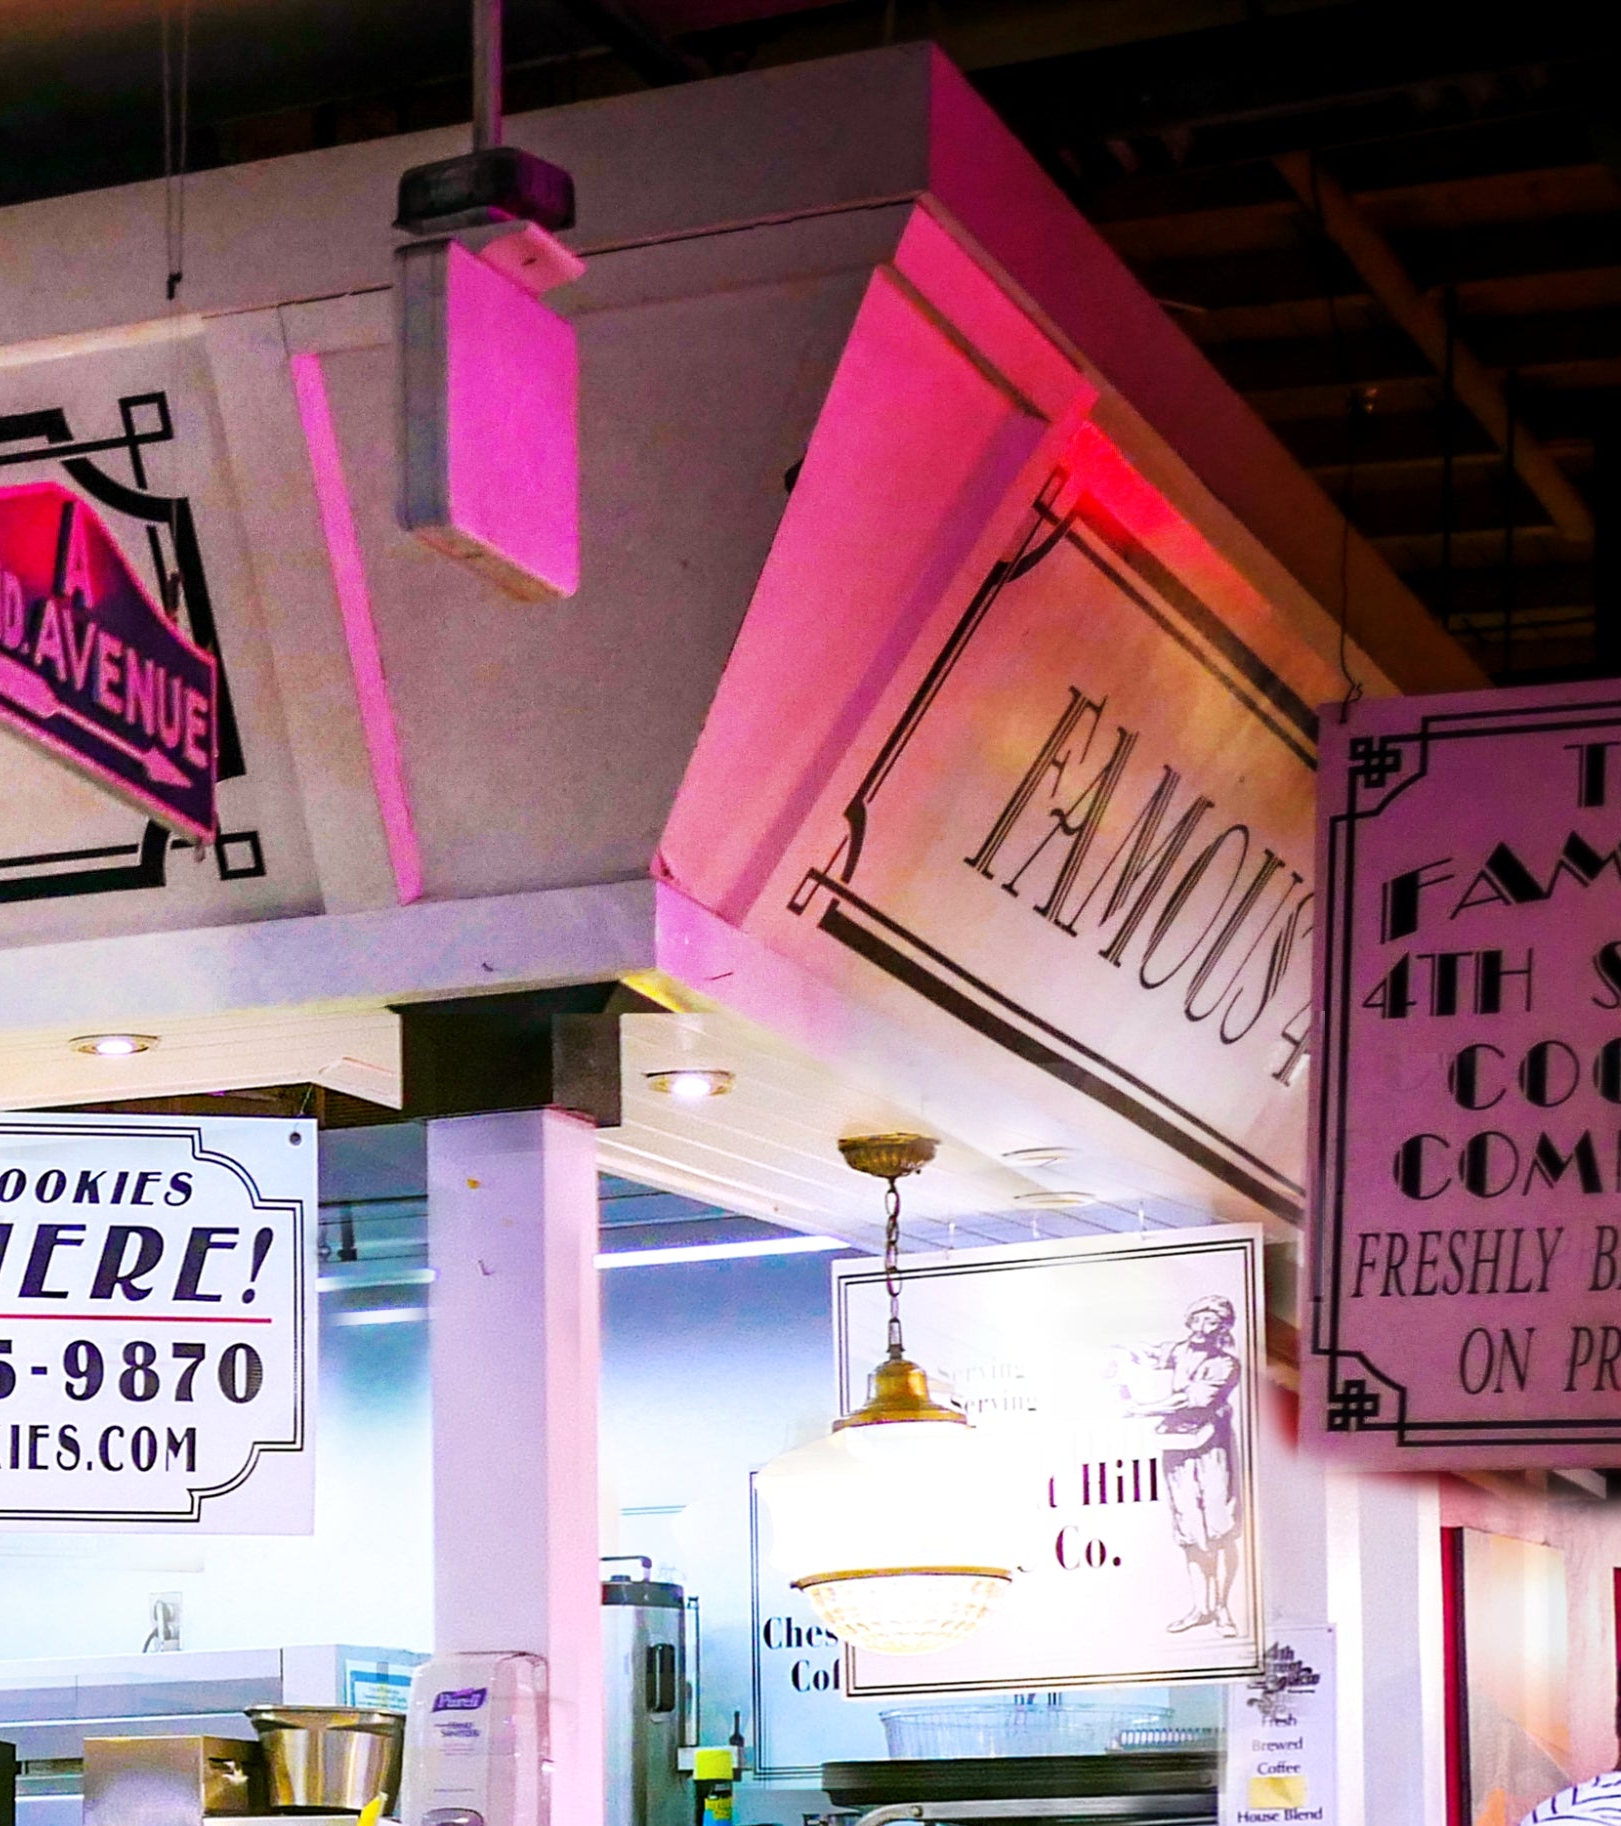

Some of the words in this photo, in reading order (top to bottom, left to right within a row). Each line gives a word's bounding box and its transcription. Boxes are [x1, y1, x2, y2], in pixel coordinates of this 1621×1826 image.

[36, 601, 209, 767] AVENUE
[964, 685, 1314, 1044] FAMOUS
[1361, 948, 1533, 1018] 4TH
[1351, 1226, 1564, 1298] FRESHLY
[1460, 1326, 1535, 1395] ON
[1055, 1526, 1121, 1571] Co.
[1252, 1737, 1303, 1752] Brewed
[1261, 1714, 1297, 1727] Fresh
[1257, 1762, 1301, 1776] Coffee
[1237, 1809, 1280, 1824] House
[1284, 1807, 1323, 1822] Blend
